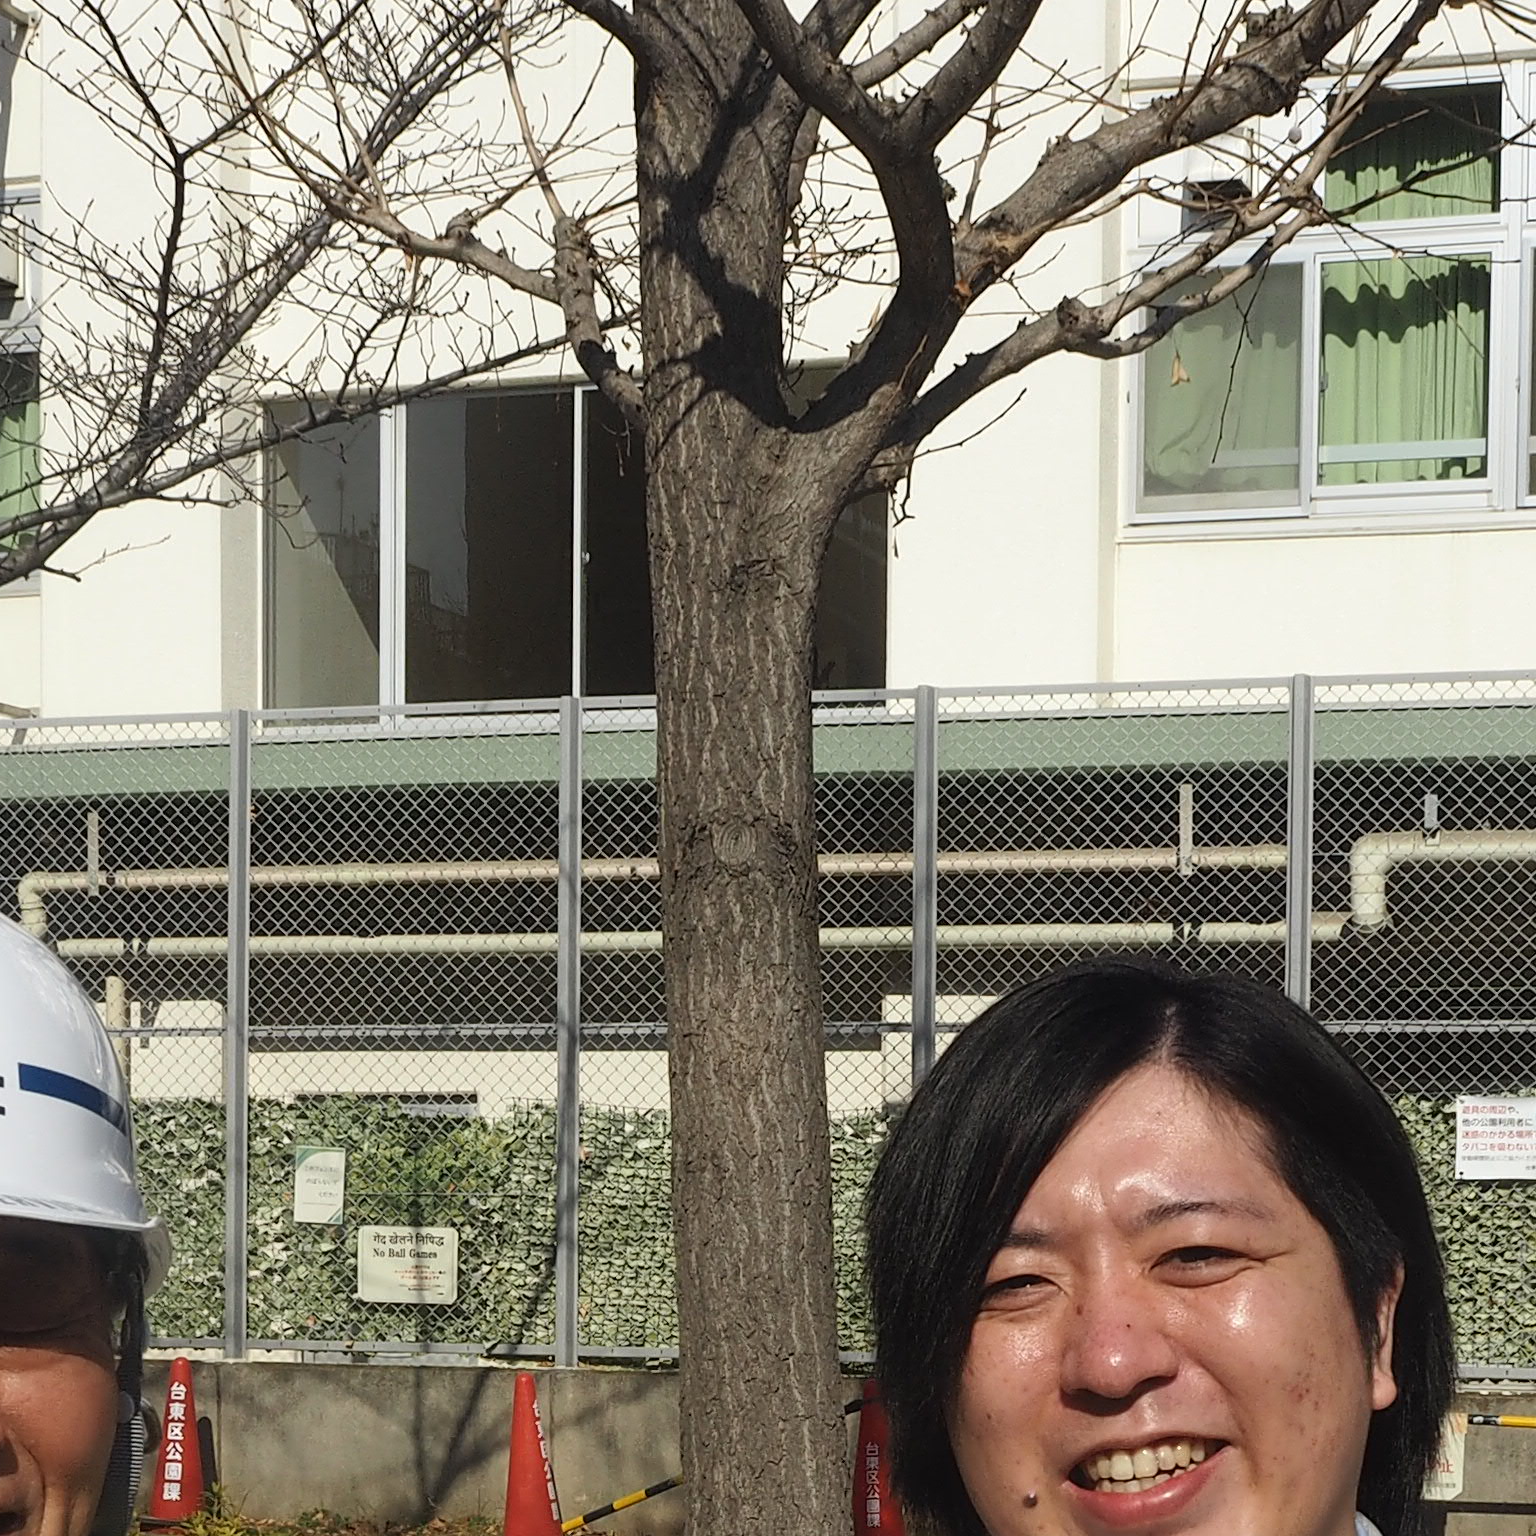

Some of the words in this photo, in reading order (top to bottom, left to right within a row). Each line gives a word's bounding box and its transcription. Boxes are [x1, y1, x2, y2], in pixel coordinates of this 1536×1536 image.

[372, 1248, 385, 1258] No
[388, 1248, 406, 1258] Ball
[409, 1248, 438, 1259] Games
[162, 1381, 188, 1502] 台東区公園課
